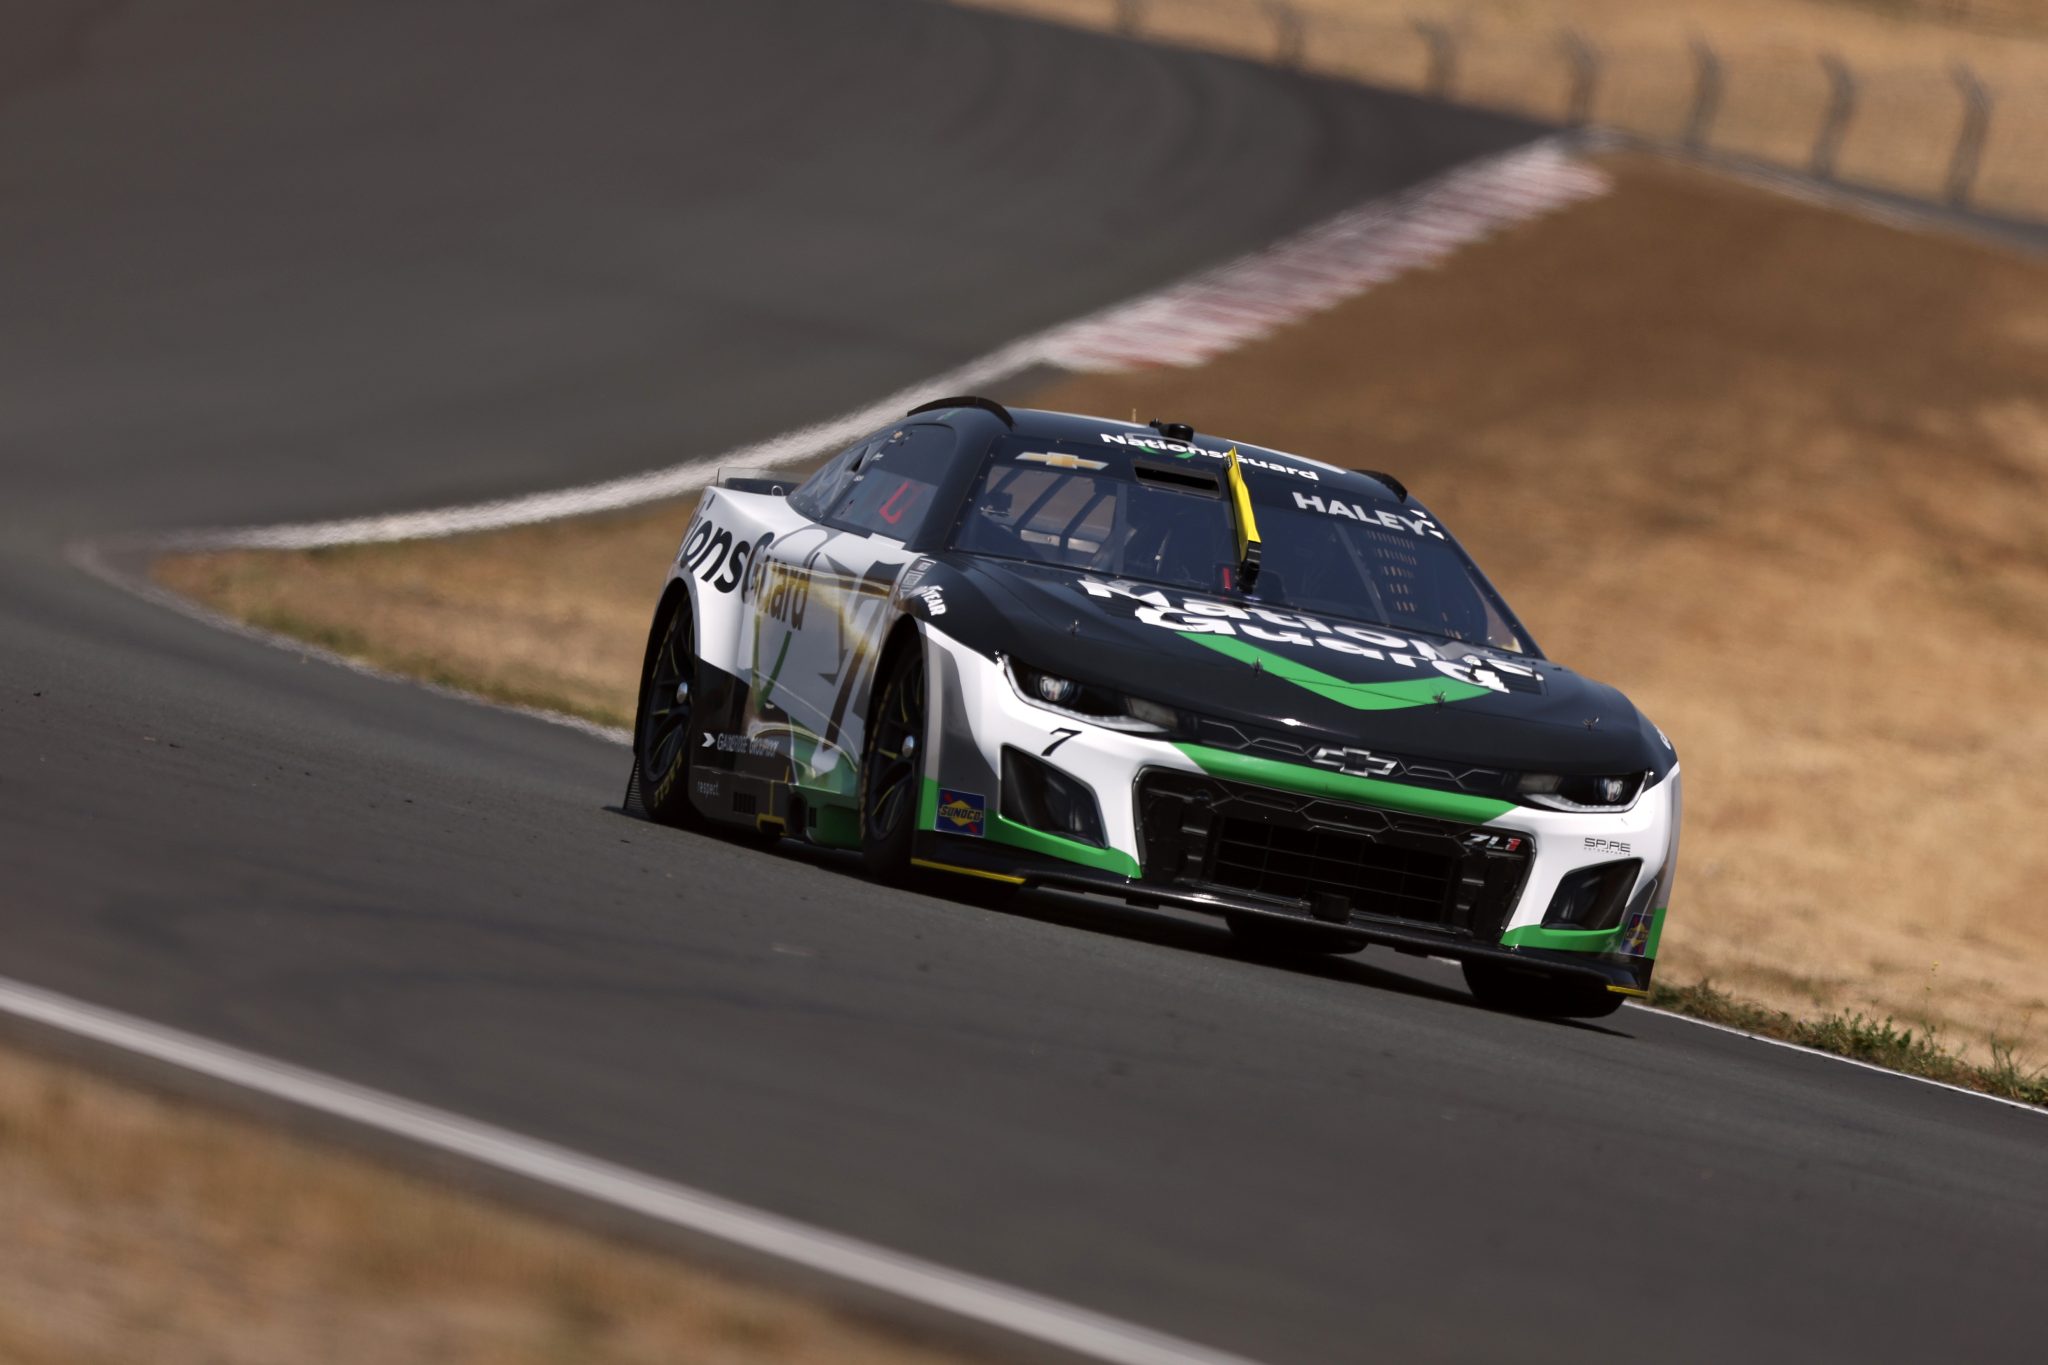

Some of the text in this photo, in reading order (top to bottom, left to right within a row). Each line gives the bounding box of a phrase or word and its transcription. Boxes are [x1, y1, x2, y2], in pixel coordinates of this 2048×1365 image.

[1291, 491, 1426, 537] HALEY
[1040, 727, 1083, 757] 7
[940, 805, 981, 821] SUNOCO
